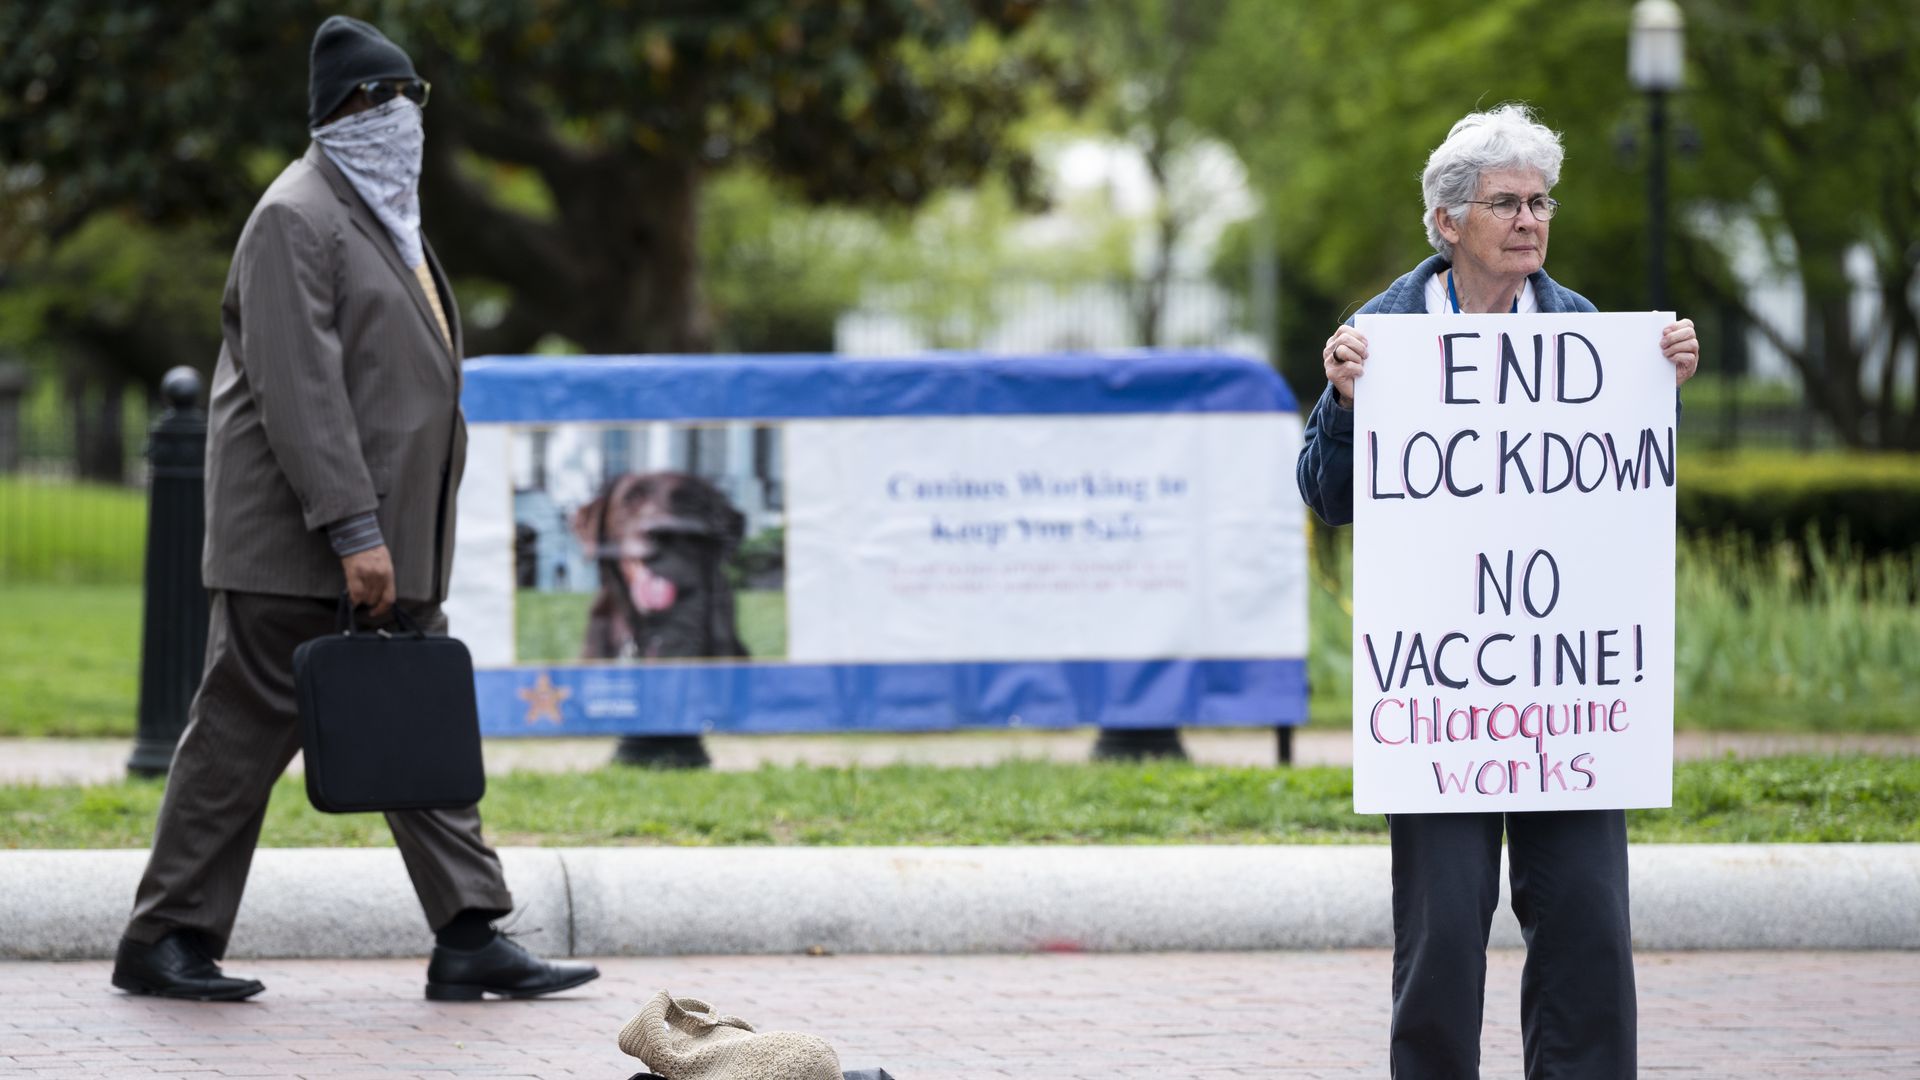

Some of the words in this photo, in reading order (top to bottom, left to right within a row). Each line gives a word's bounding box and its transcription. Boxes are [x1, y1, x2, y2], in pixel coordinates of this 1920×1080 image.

[1438, 331, 1603, 404] END
[1017, 470, 1148, 502] Working
[1367, 426, 1674, 499] LOCKDOWN
[1474, 549, 1560, 618] NO
[1363, 624, 1643, 692] VACCINE!
[1370, 696, 1629, 753] Chloroquine
[1432, 752, 1597, 795] works
